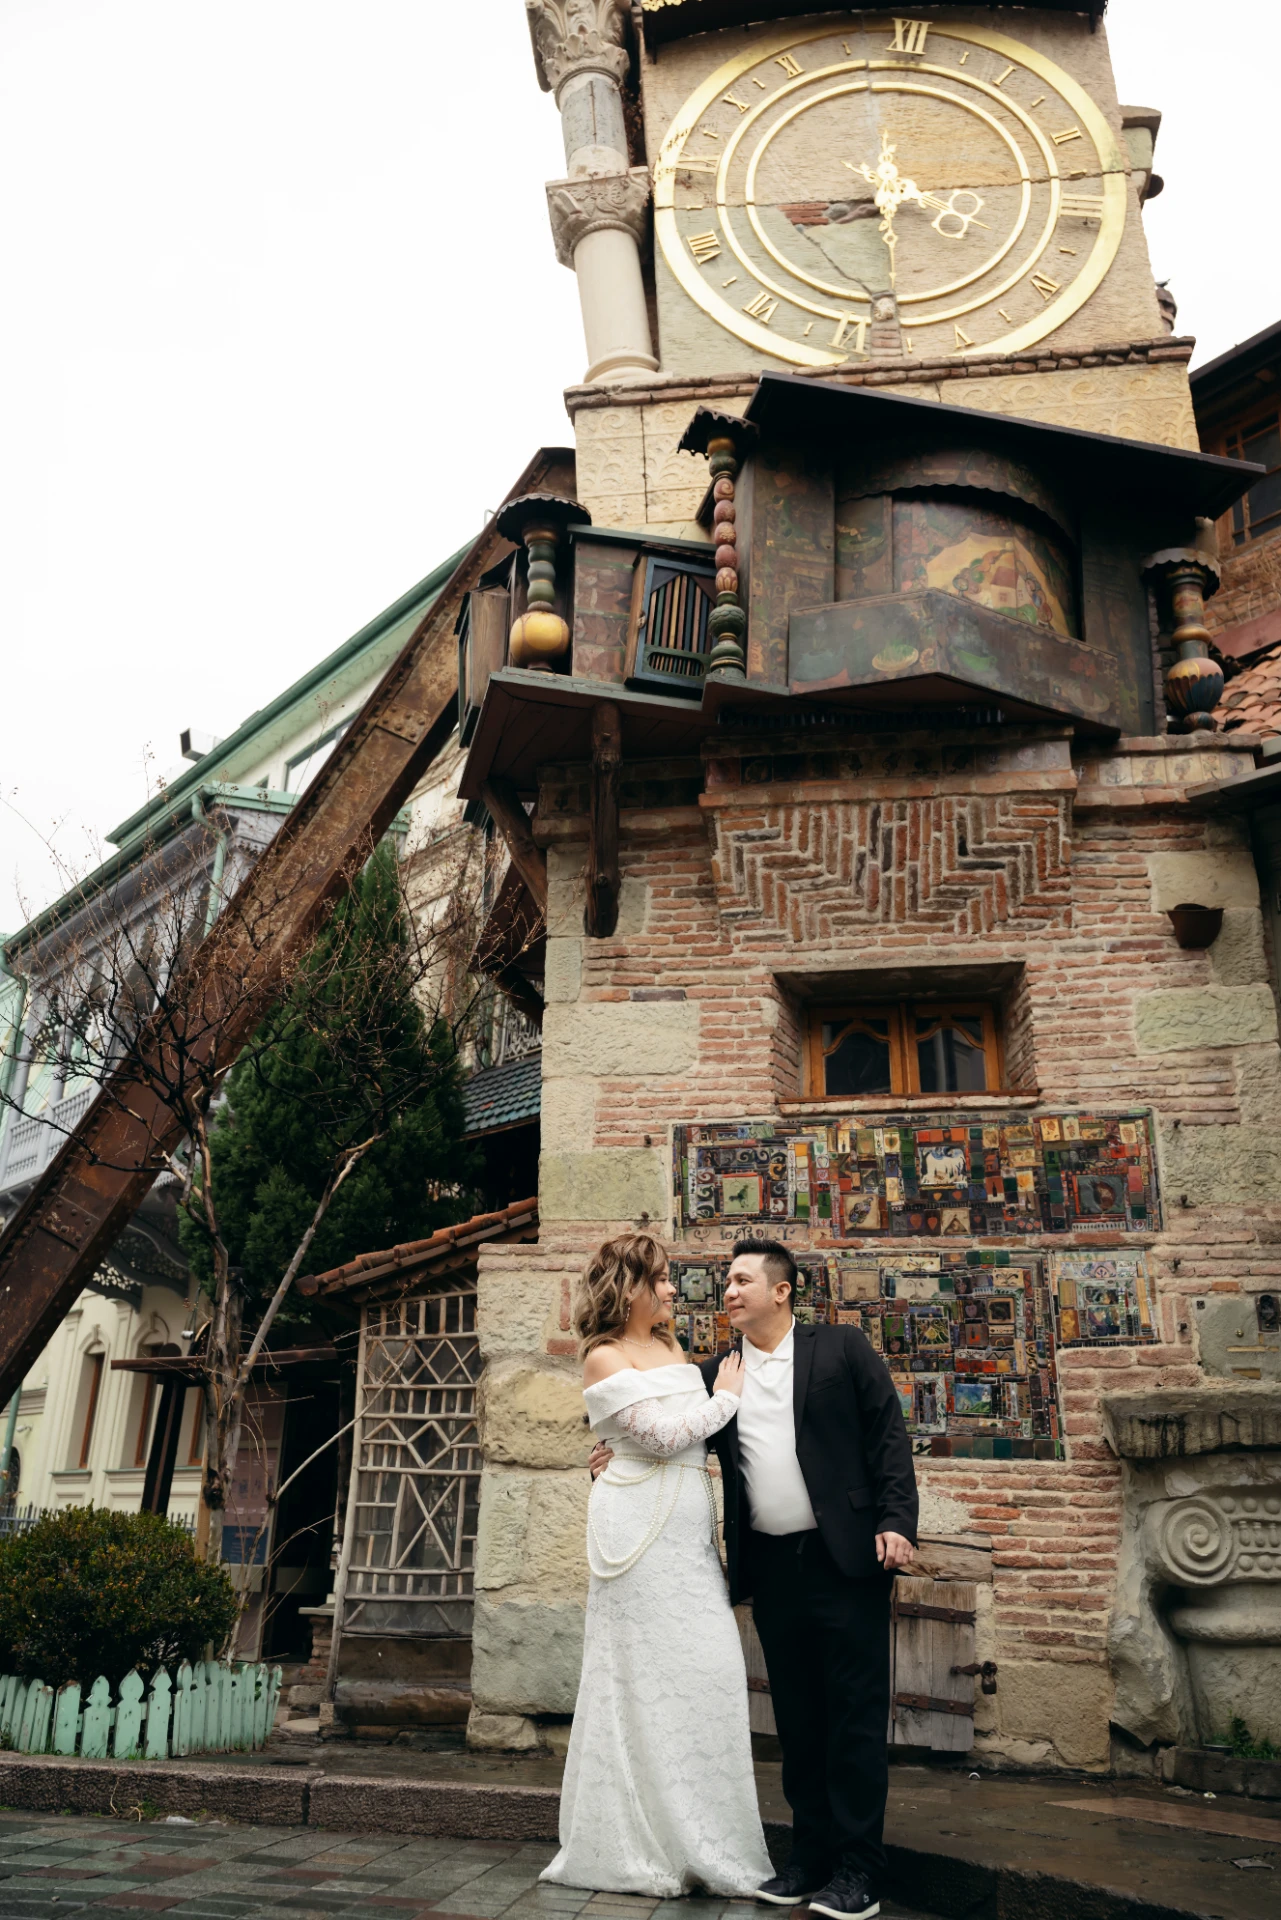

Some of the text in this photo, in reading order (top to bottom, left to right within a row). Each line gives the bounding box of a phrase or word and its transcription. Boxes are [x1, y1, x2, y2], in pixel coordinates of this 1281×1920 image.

[885, 17, 933, 55] XII
[774, 54, 806, 80] XI
[722, 91, 751, 114] X
[1030, 270, 1062, 301] IV
[742, 291, 779, 325] VII
[826, 310, 871, 355] VI
[954, 324, 976, 349] V
